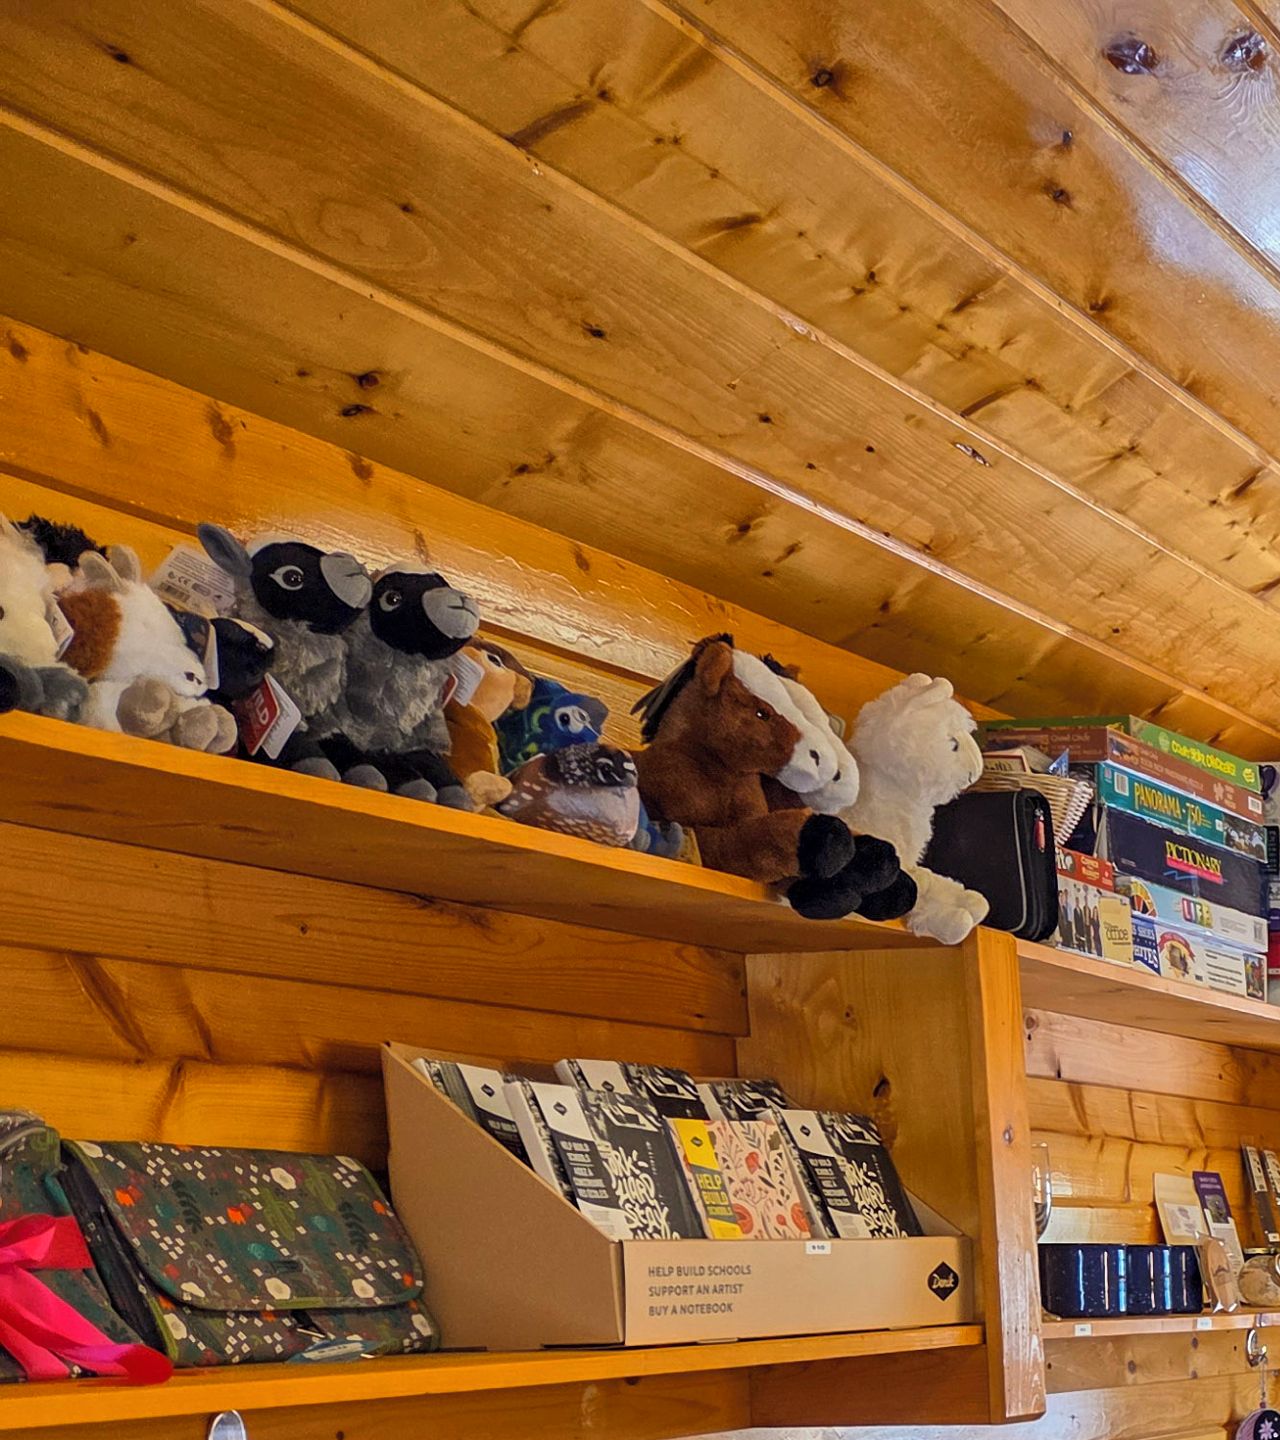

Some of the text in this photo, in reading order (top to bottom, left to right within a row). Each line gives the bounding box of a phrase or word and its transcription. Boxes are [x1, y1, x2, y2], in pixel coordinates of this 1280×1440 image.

[1134, 782, 1182, 820] PANORAMA
[1165, 841, 1222, 874] PICTIONARY
[1182, 898, 1213, 928] LIFE
[697, 1174, 723, 1190] HELP
[648, 1264, 752, 1278] HELP BUILD SCHOOLS
[648, 1283, 744, 1297] SUPPORT AN ARTIST
[648, 1303, 733, 1316] BUY A NOTEBOOK
